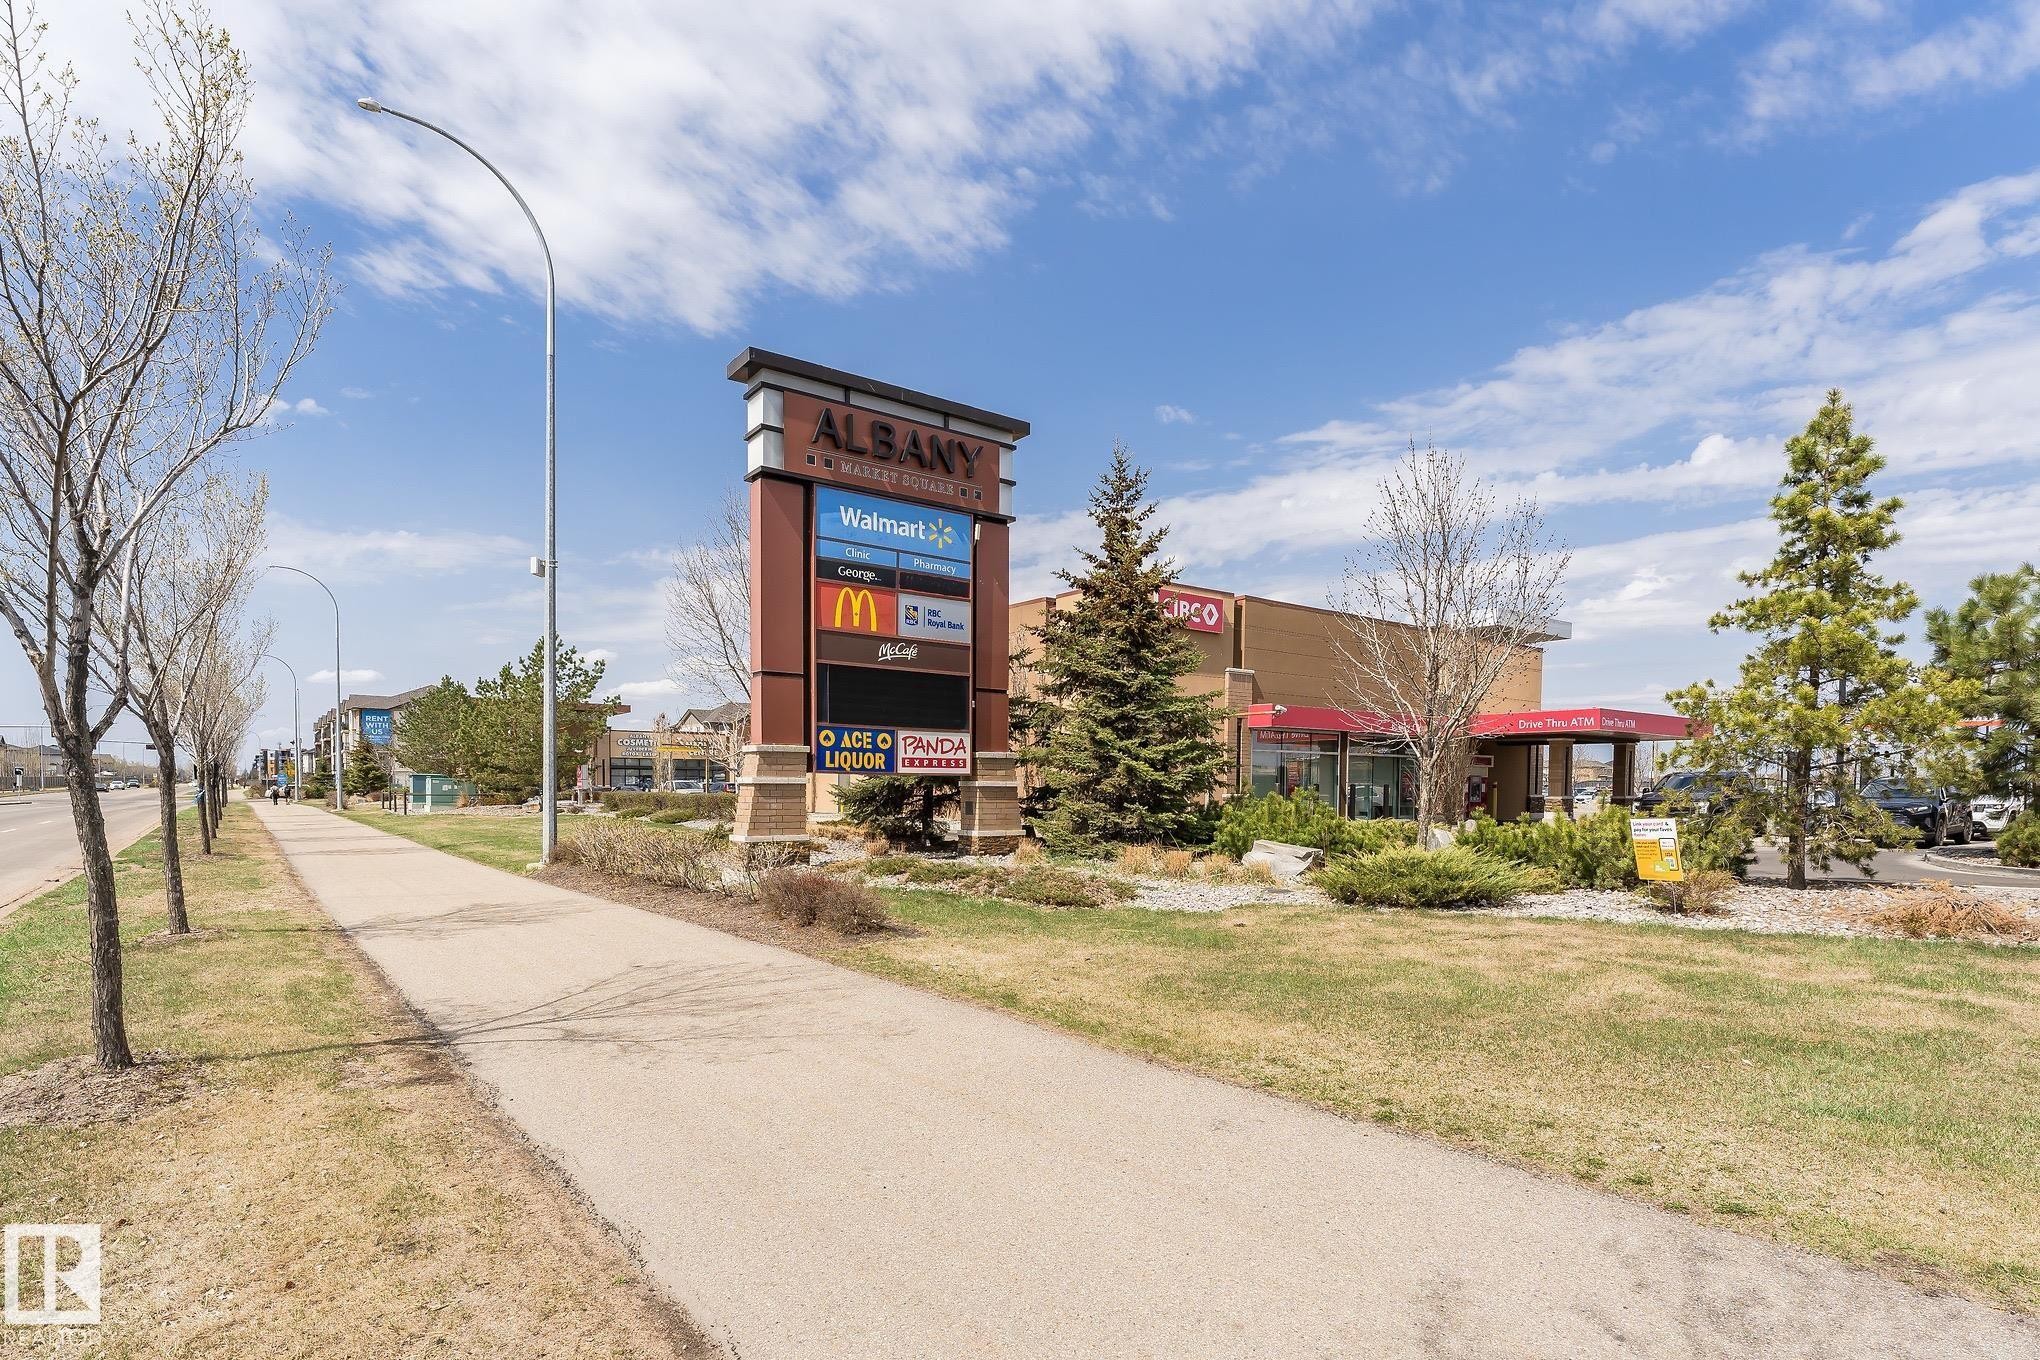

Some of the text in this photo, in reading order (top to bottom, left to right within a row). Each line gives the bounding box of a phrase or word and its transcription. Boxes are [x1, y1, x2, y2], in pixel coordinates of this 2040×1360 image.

[812, 408, 983, 478] ALBANY
[840, 460, 955, 496] MARKET SQUARE
[839, 505, 926, 540] Walmart
[845, 547, 871, 560] Clinic
[914, 558, 957, 576] Pharmacy
[927, 608, 942, 618] RBC
[927, 619, 966, 630] Royal Bank
[1518, 717, 1595, 729] Drive Thru ATM
[1602, 716, 1636, 728] Drive Thru ATM
[840, 731, 873, 749] ACE
[901, 735, 966, 756] PANDA
[825, 750, 886, 771] LIQUOR
[904, 758, 964, 767] EXPRESS
